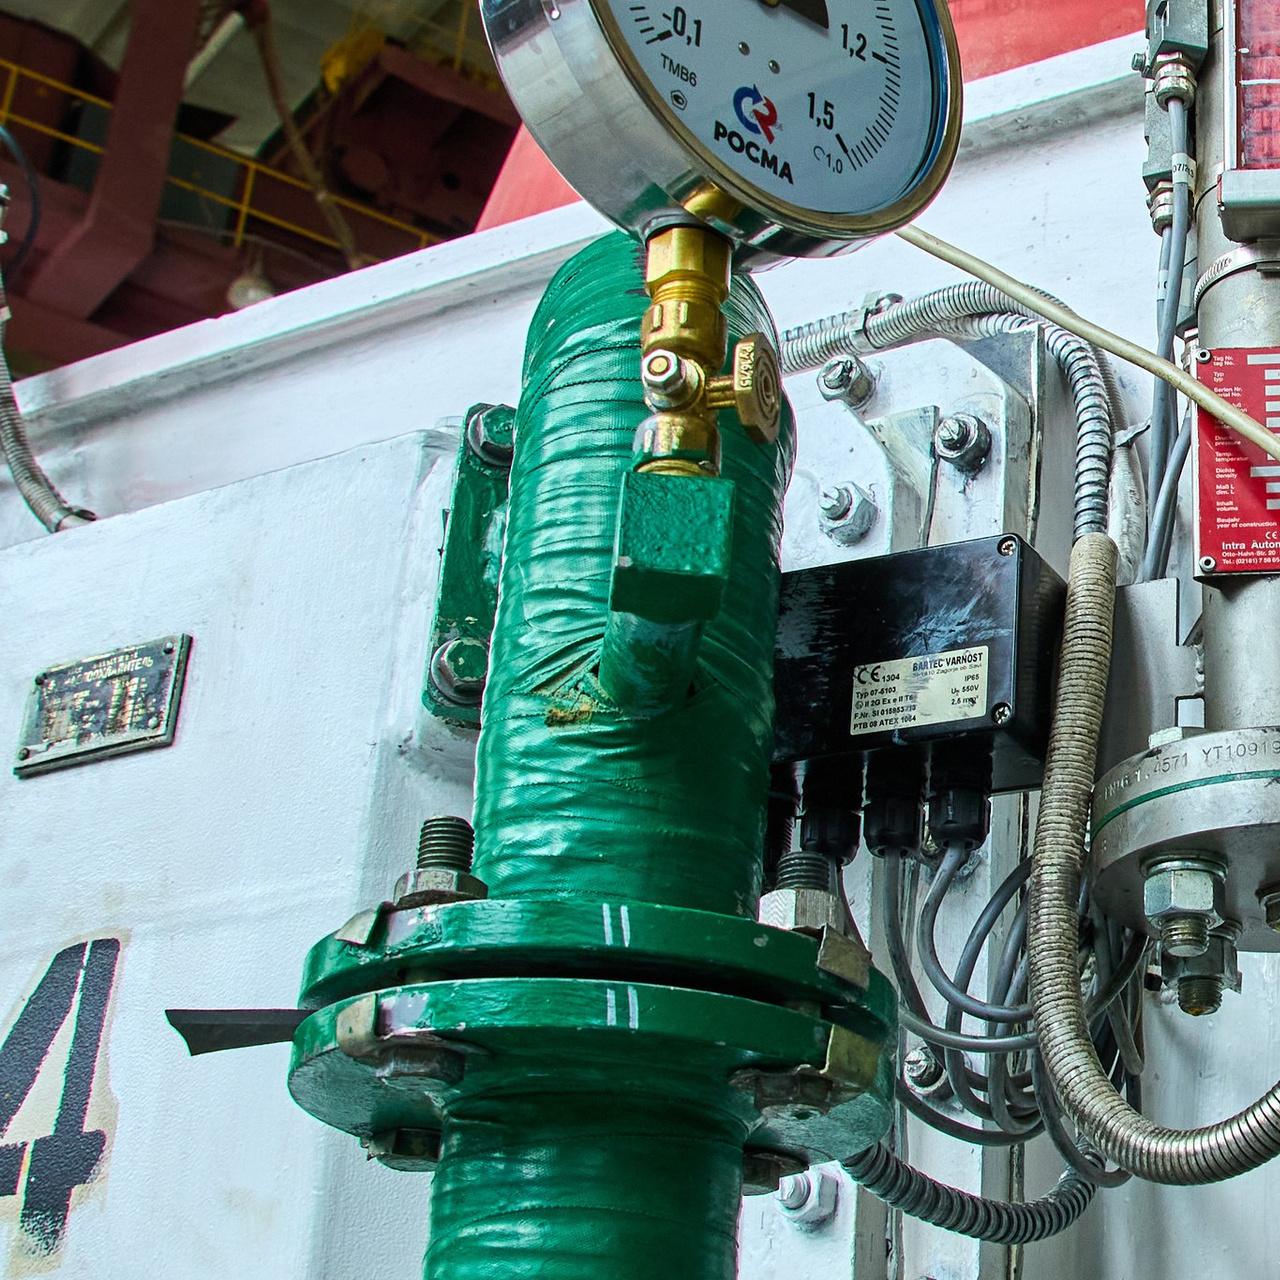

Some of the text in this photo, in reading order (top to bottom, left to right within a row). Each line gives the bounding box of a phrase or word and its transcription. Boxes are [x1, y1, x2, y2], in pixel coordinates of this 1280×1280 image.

[662, 6, 702, 48] -0,1
[841, 23, 867, 62] 1,2
[807, 92, 834, 130] 1,5
[714, 120, 794, 185] РОСМА
[1222, 541, 1246, 550] Intra
[945, 652, 983, 666] VARNOST
[882, 673, 900, 682] 1304
[964, 674, 980, 682] IP65
[856, 691, 869, 699] Typ
[853, 722, 868, 730] PTB
[879, 718, 899, 727] ATEX
